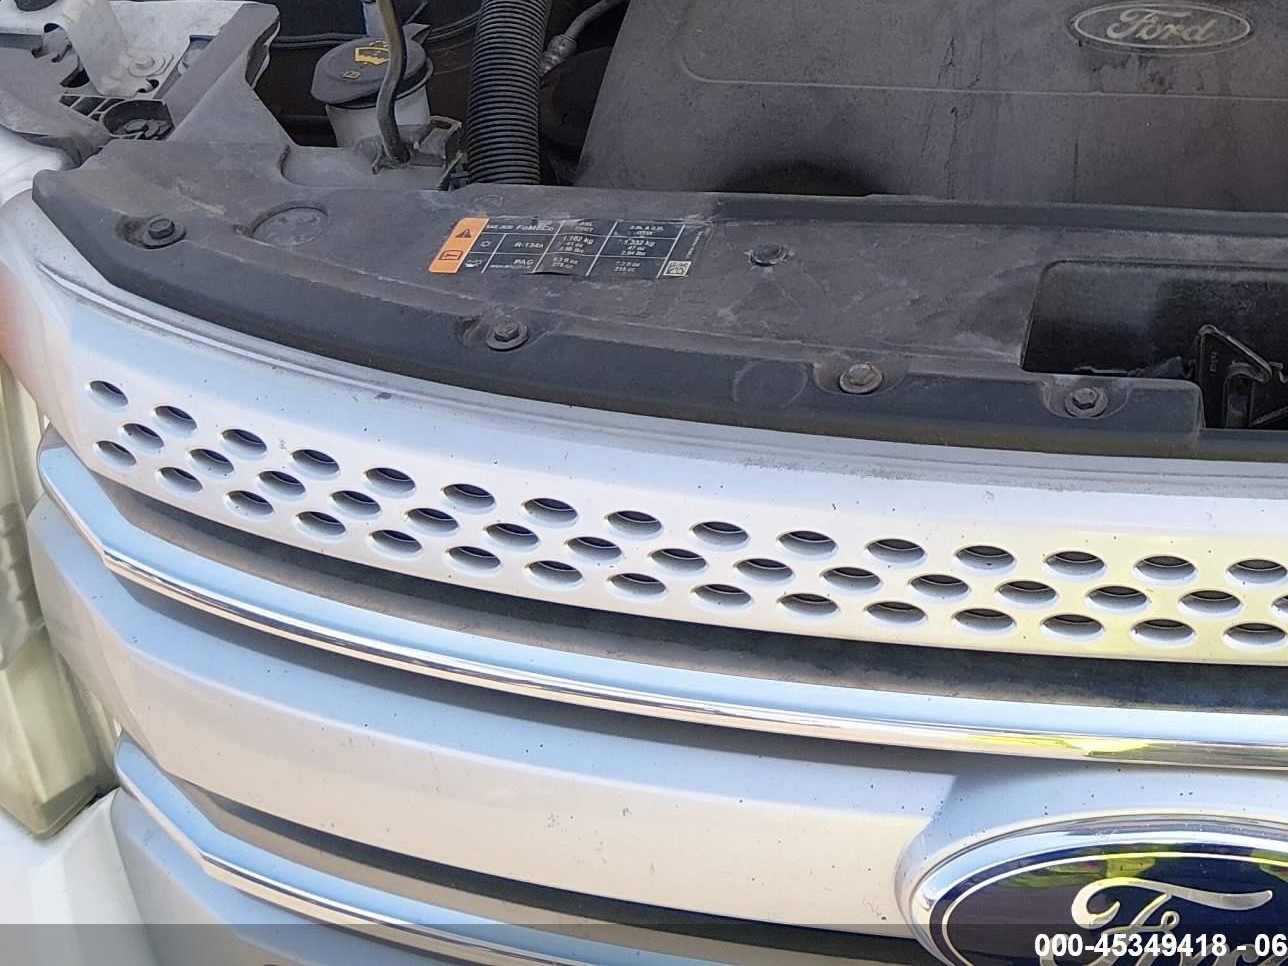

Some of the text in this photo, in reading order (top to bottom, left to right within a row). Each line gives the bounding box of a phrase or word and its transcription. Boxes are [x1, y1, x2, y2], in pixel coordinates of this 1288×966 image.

[1106, 8, 1217, 42] Ford
[515, 224, 554, 232] FoMoCo
[513, 241, 545, 249] R-134a
